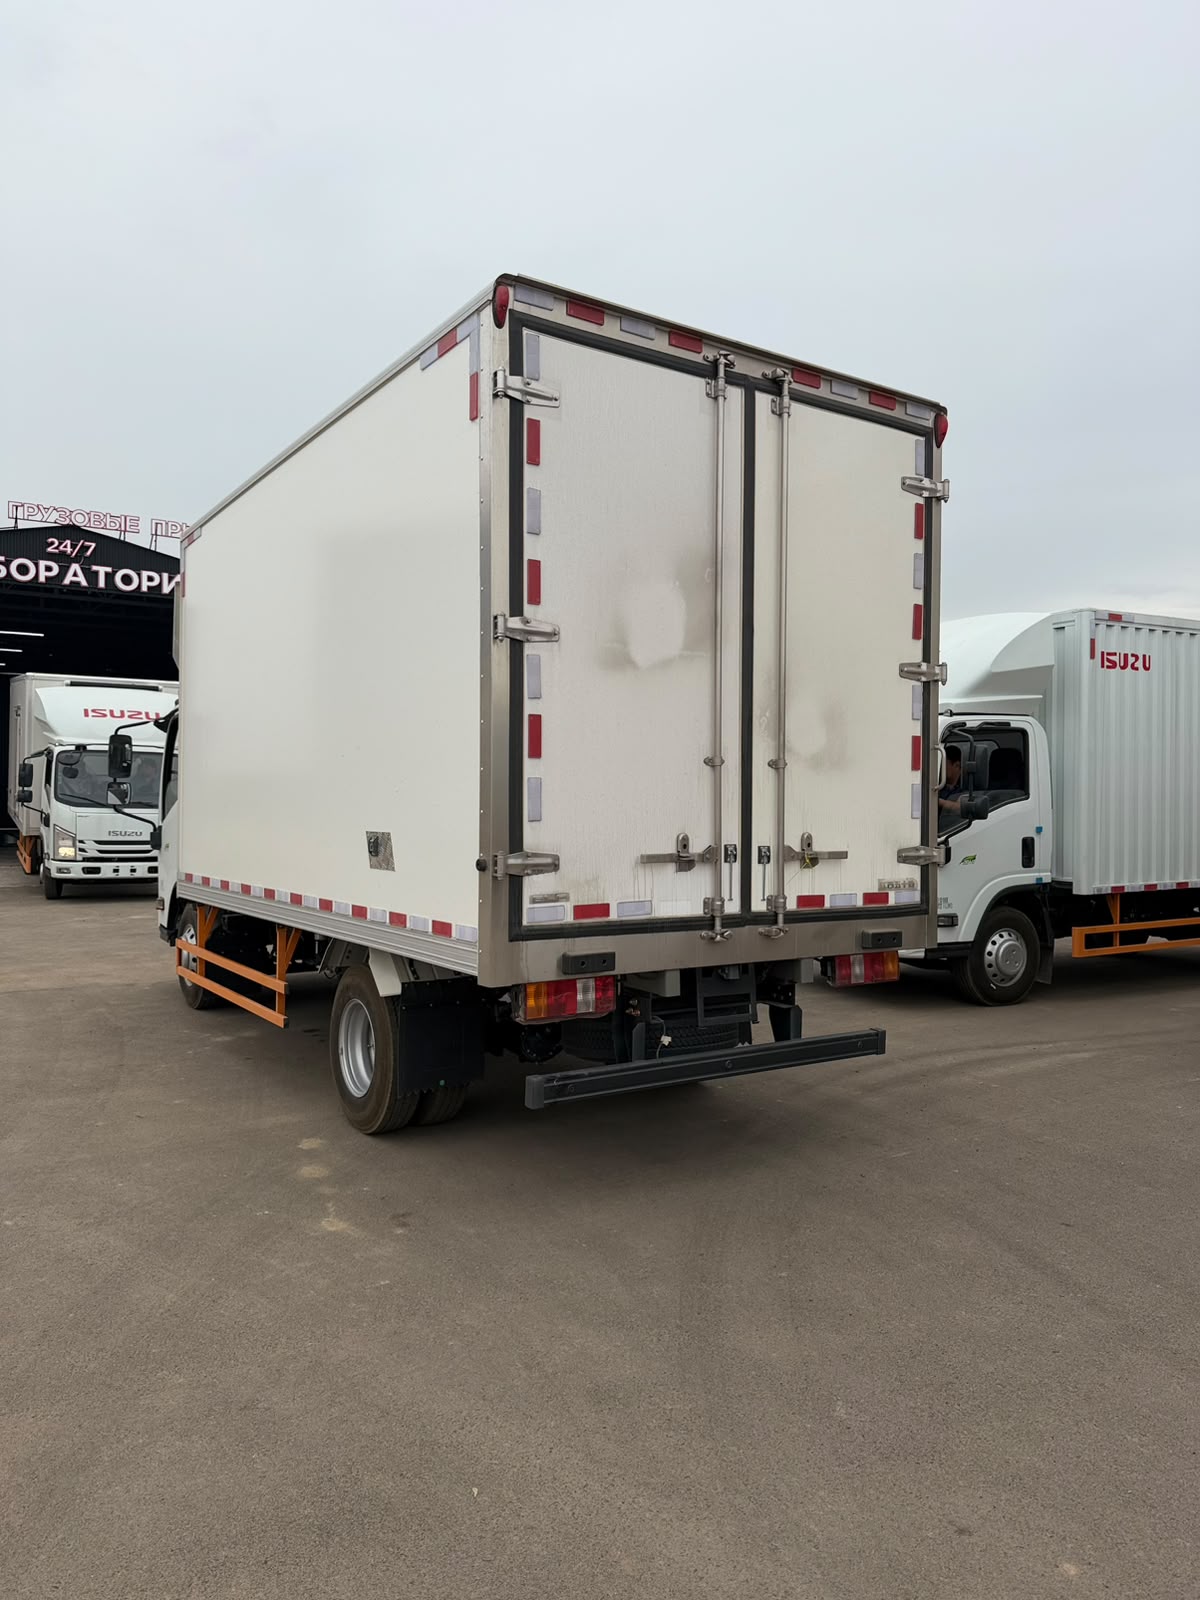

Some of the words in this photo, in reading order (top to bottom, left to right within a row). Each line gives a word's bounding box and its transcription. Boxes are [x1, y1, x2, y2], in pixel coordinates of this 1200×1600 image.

[8, 501, 140, 533] ГРУЗОВЫЕ
[151, 518, 190, 538] ПР
[46, 538, 96, 558] 24/7
[1100, 651, 1151, 671] ISUZU
[83, 708, 161, 721] ISUZU
